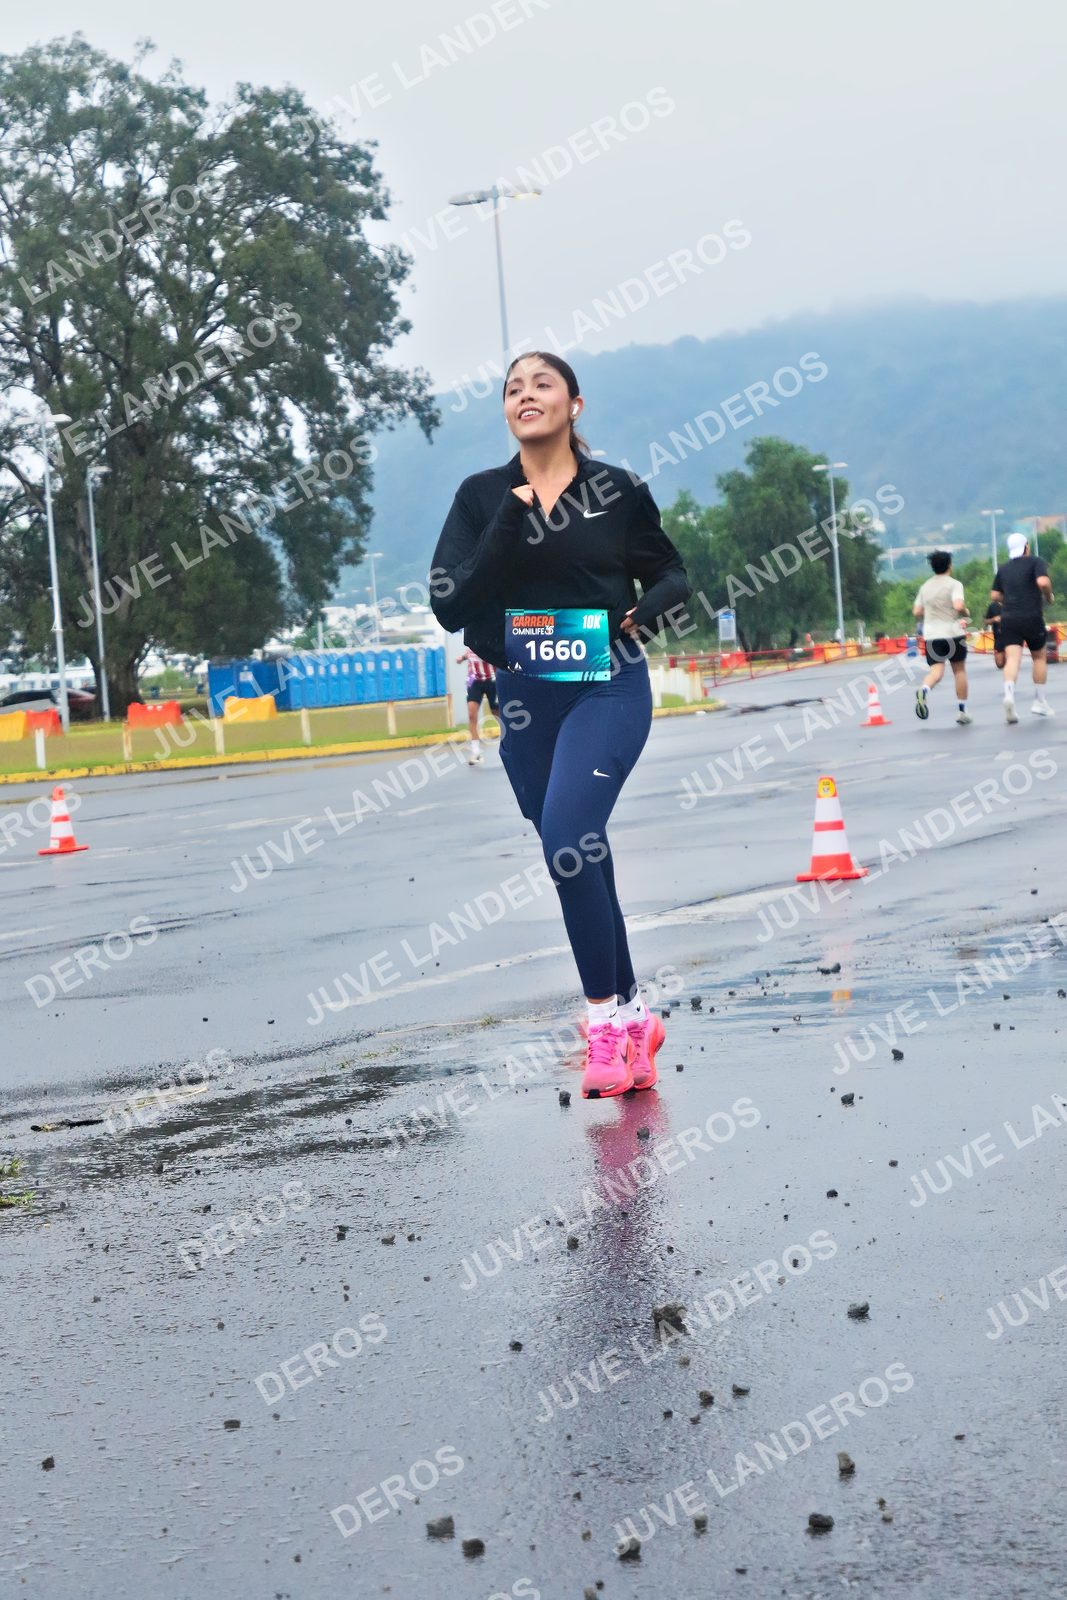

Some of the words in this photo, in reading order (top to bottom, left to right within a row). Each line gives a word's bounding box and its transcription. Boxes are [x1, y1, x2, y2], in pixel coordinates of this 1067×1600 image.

[512, 615, 555, 627] CARRERA
[582, 614, 601, 629] 10K
[525, 640, 587, 661] 1660
